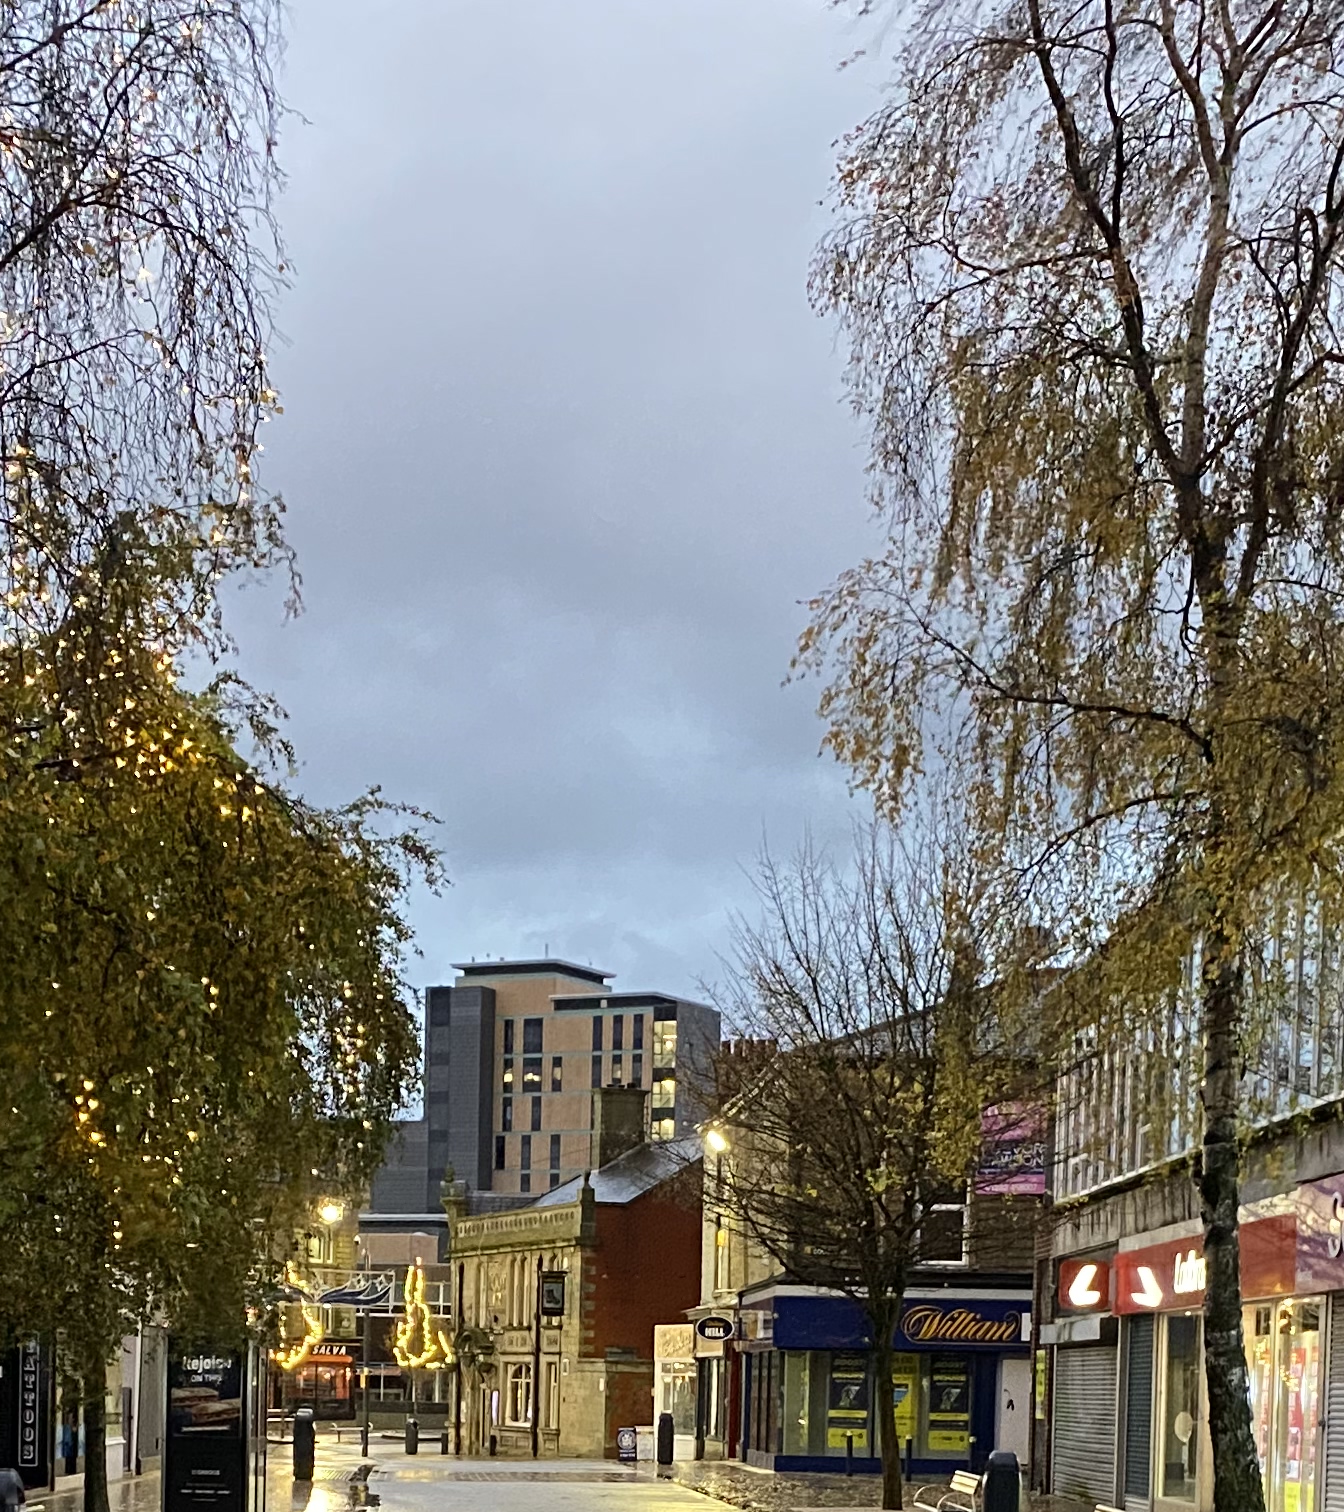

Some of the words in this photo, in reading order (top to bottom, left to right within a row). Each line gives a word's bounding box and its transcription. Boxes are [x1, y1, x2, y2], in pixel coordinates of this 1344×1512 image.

[900, 1305, 1020, 1342] William
[705, 1327, 724, 1337] HILL
[312, 1345, 346, 1356] SALVA
